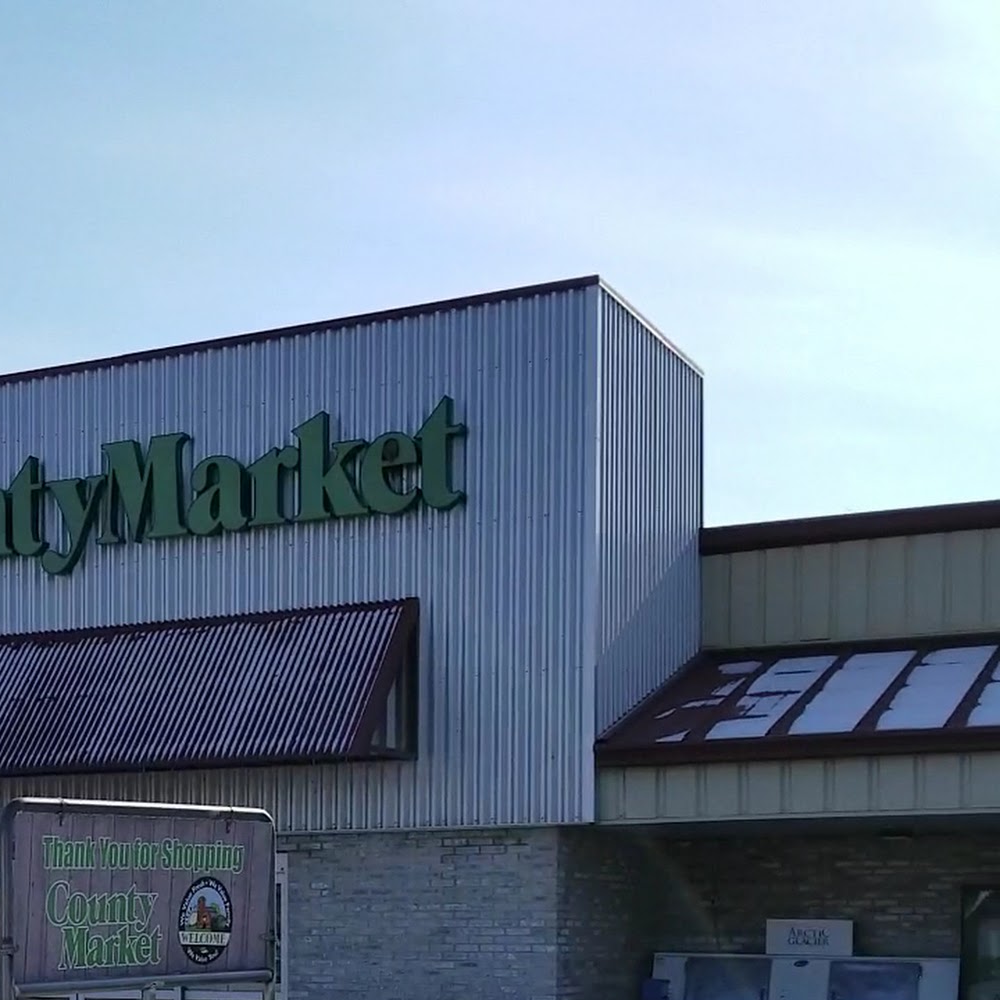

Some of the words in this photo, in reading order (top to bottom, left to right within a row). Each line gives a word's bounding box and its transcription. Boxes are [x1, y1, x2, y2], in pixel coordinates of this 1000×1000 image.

[42, 835, 95, 869] Thank
[99, 836, 133, 870] You
[132, 837, 159, 870] for
[160, 838, 245, 874] Shopping
[45, 880, 159, 932] County
[57, 923, 163, 971] Market
[182, 932, 226, 944] WELCOME
